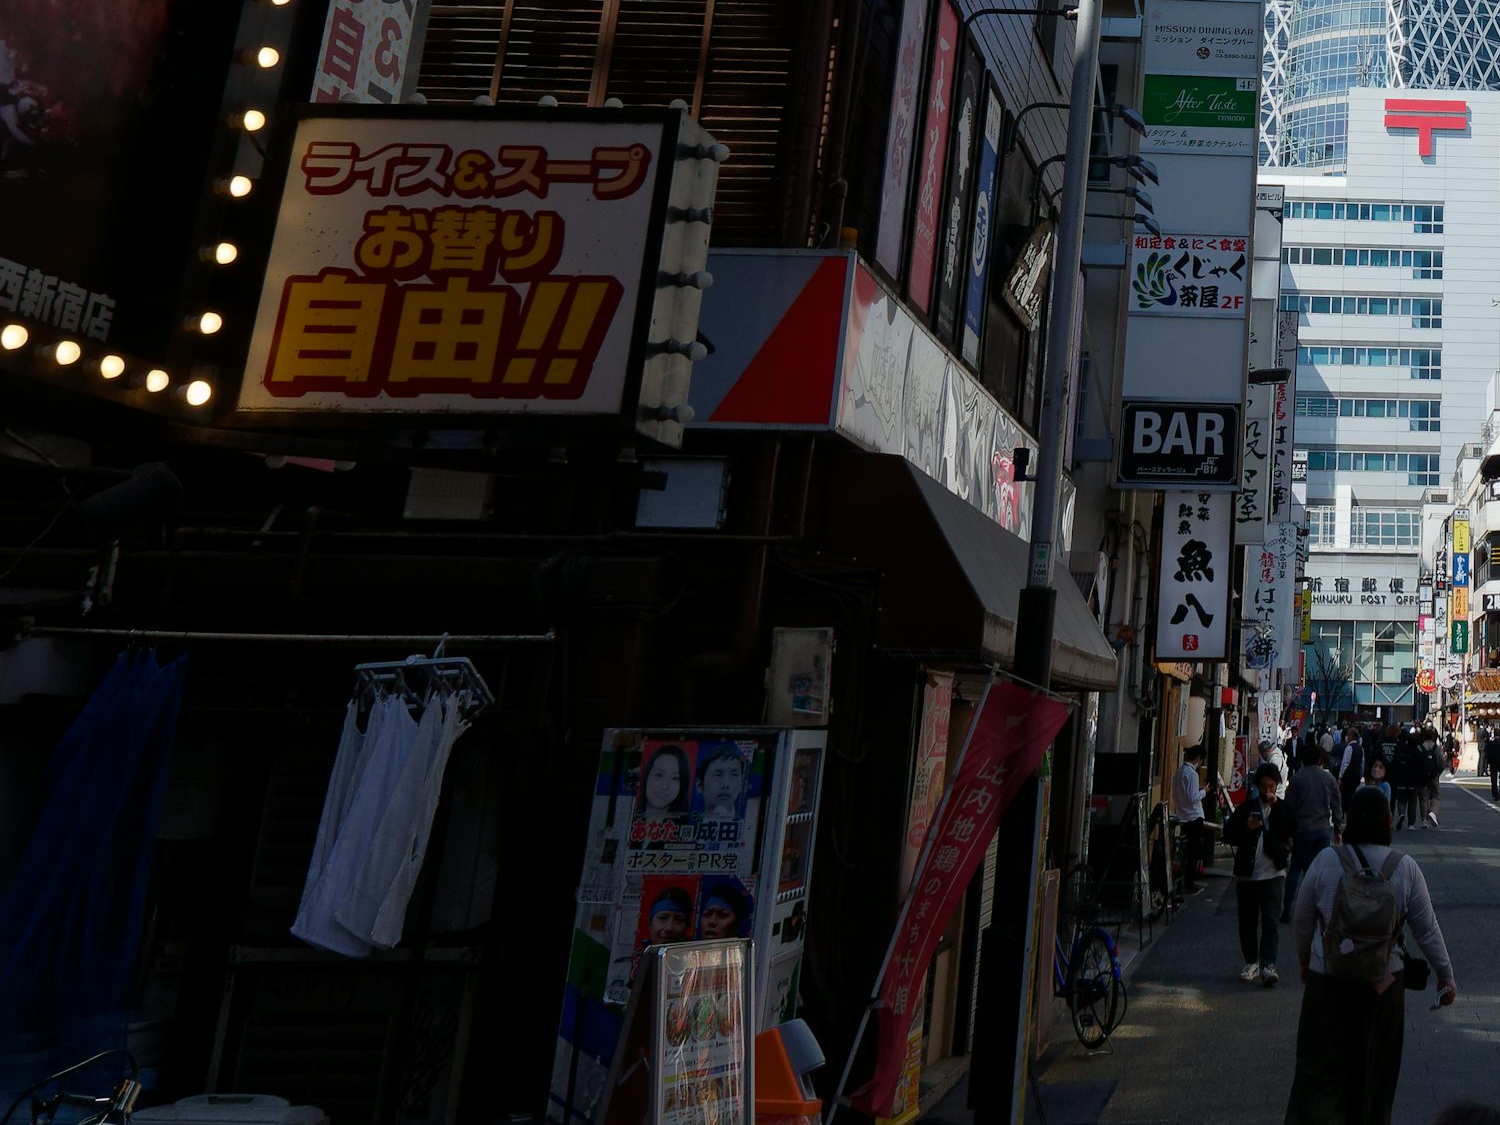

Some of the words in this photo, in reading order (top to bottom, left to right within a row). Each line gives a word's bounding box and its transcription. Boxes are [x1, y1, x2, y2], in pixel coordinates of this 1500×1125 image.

[1154, 35, 1193, 44] ミッション
[1200, 37, 1254, 46] ダイニングバー
[1155, 25, 1196, 34] MISSION
[1198, 26, 1231, 35] DINING
[1234, 28, 1254, 36] BAR
[1239, 80, 1254, 90] 4F
[1164, 88, 1204, 122] After
[1206, 92, 1238, 111] Taste
[302, 142, 653, 200] ライス&スープ
[355, 206, 564, 283] お替り
[1134, 236, 1246, 251] 和定食&にく食堂
[1173, 252, 1245, 281] くじゃく
[1180, 285, 1218, 308] 茶屋
[1221, 296, 1244, 309] 2F
[263, 268, 625, 400] 自由!!
[1132, 411, 1225, 455] BAR
[1203, 465, 1219, 474] B1F
[1170, 539, 1214, 628] 魚八
[1307, 577, 1419, 594] 新宿郵便
[1311, 595, 1353, 604] HINJUKU
[1361, 595, 1387, 605] POST
[630, 821, 679, 843] あなた
[697, 821, 738, 843] 成田
[626, 853, 687, 869] ポスター
